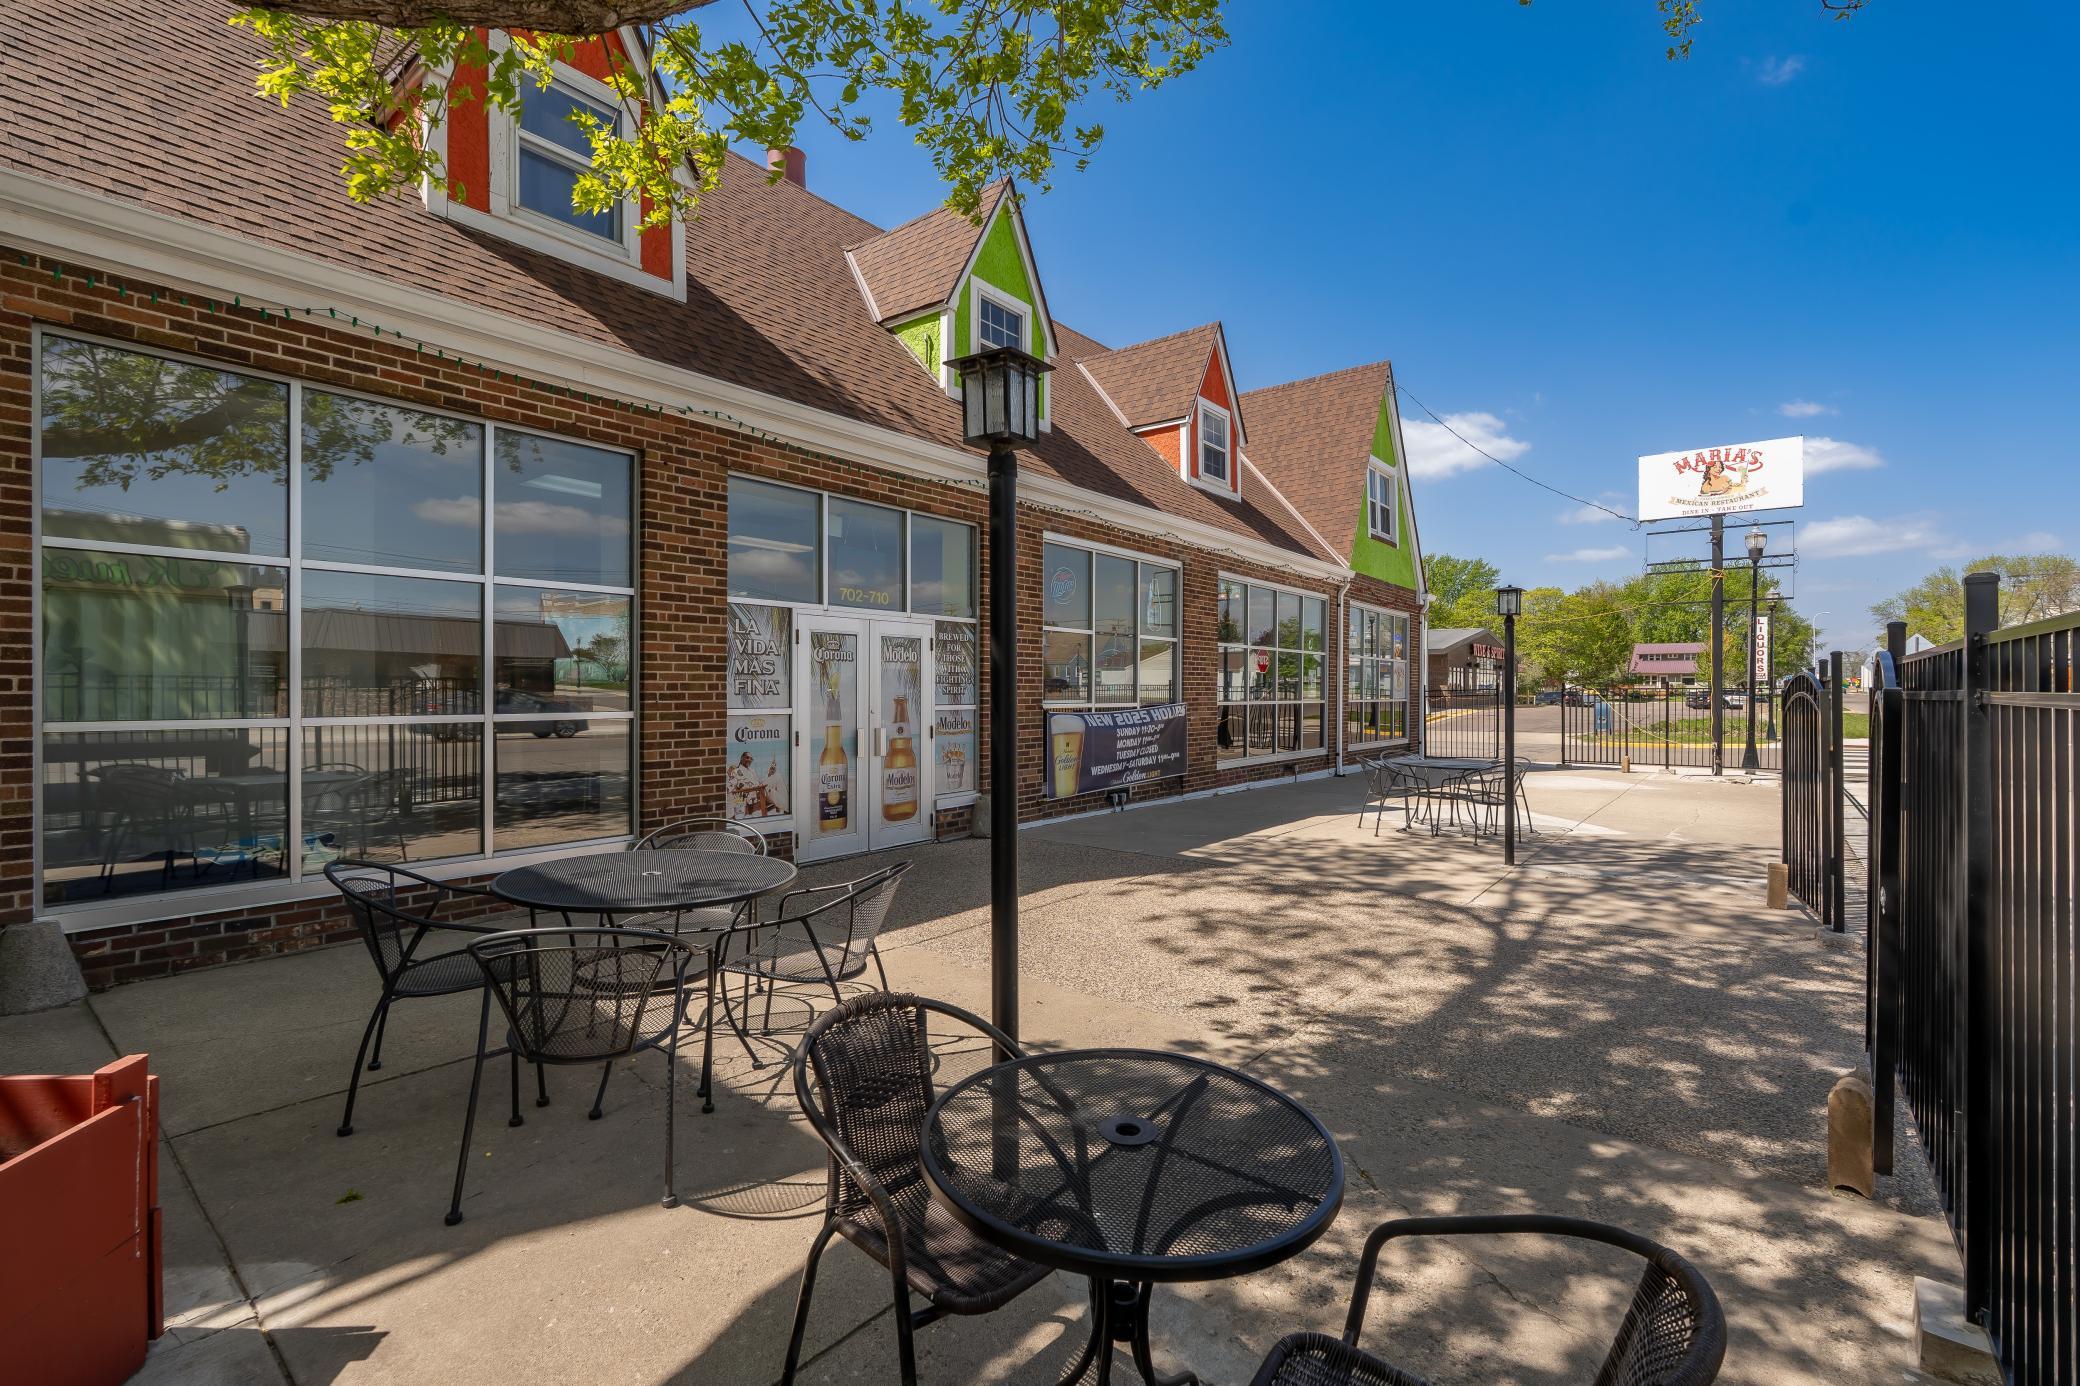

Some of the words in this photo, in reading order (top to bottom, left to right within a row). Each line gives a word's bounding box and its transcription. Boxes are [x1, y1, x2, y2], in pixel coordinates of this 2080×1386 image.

[1673, 448, 1763, 475] MARIA'S
[1676, 498, 1709, 507] MEXICAN
[1711, 490, 1760, 506] RESTAURANT
[839, 587, 889, 605] 702-710
[735, 618, 761, 635] LA
[938, 632, 969, 641] BREWED
[735, 639, 780, 656] VIDA
[947, 643, 962, 652] FOR
[1473, 643, 1486, 657] WINE
[1756, 618, 1765, 672] LIQUORS
[814, 646, 853, 663] Corona
[883, 645, 918, 662] Modelo
[943, 654, 965, 663] THOSE
[941, 664, 960, 673] WITH
[936, 674, 972, 684] FIGHTING
[734, 679, 779, 695] FINA
[942, 685, 965, 695] SPIRIT
[939, 716, 968, 731] Modelo
[1084, 714, 1114, 727] NEW
[1113, 710, 1150, 726] 2025
[1150, 705, 1186, 721] HOURS
[734, 726, 780, 744] Corona
[1116, 726, 1140, 738] SUNDAY
[1116, 737, 1141, 749] MONDAY
[1116, 749, 1139, 761] TUESDAY
[1139, 744, 1159, 756] CLOSED
[887, 771, 913, 786] Modelo
[1122, 769, 1147, 784] Golden
